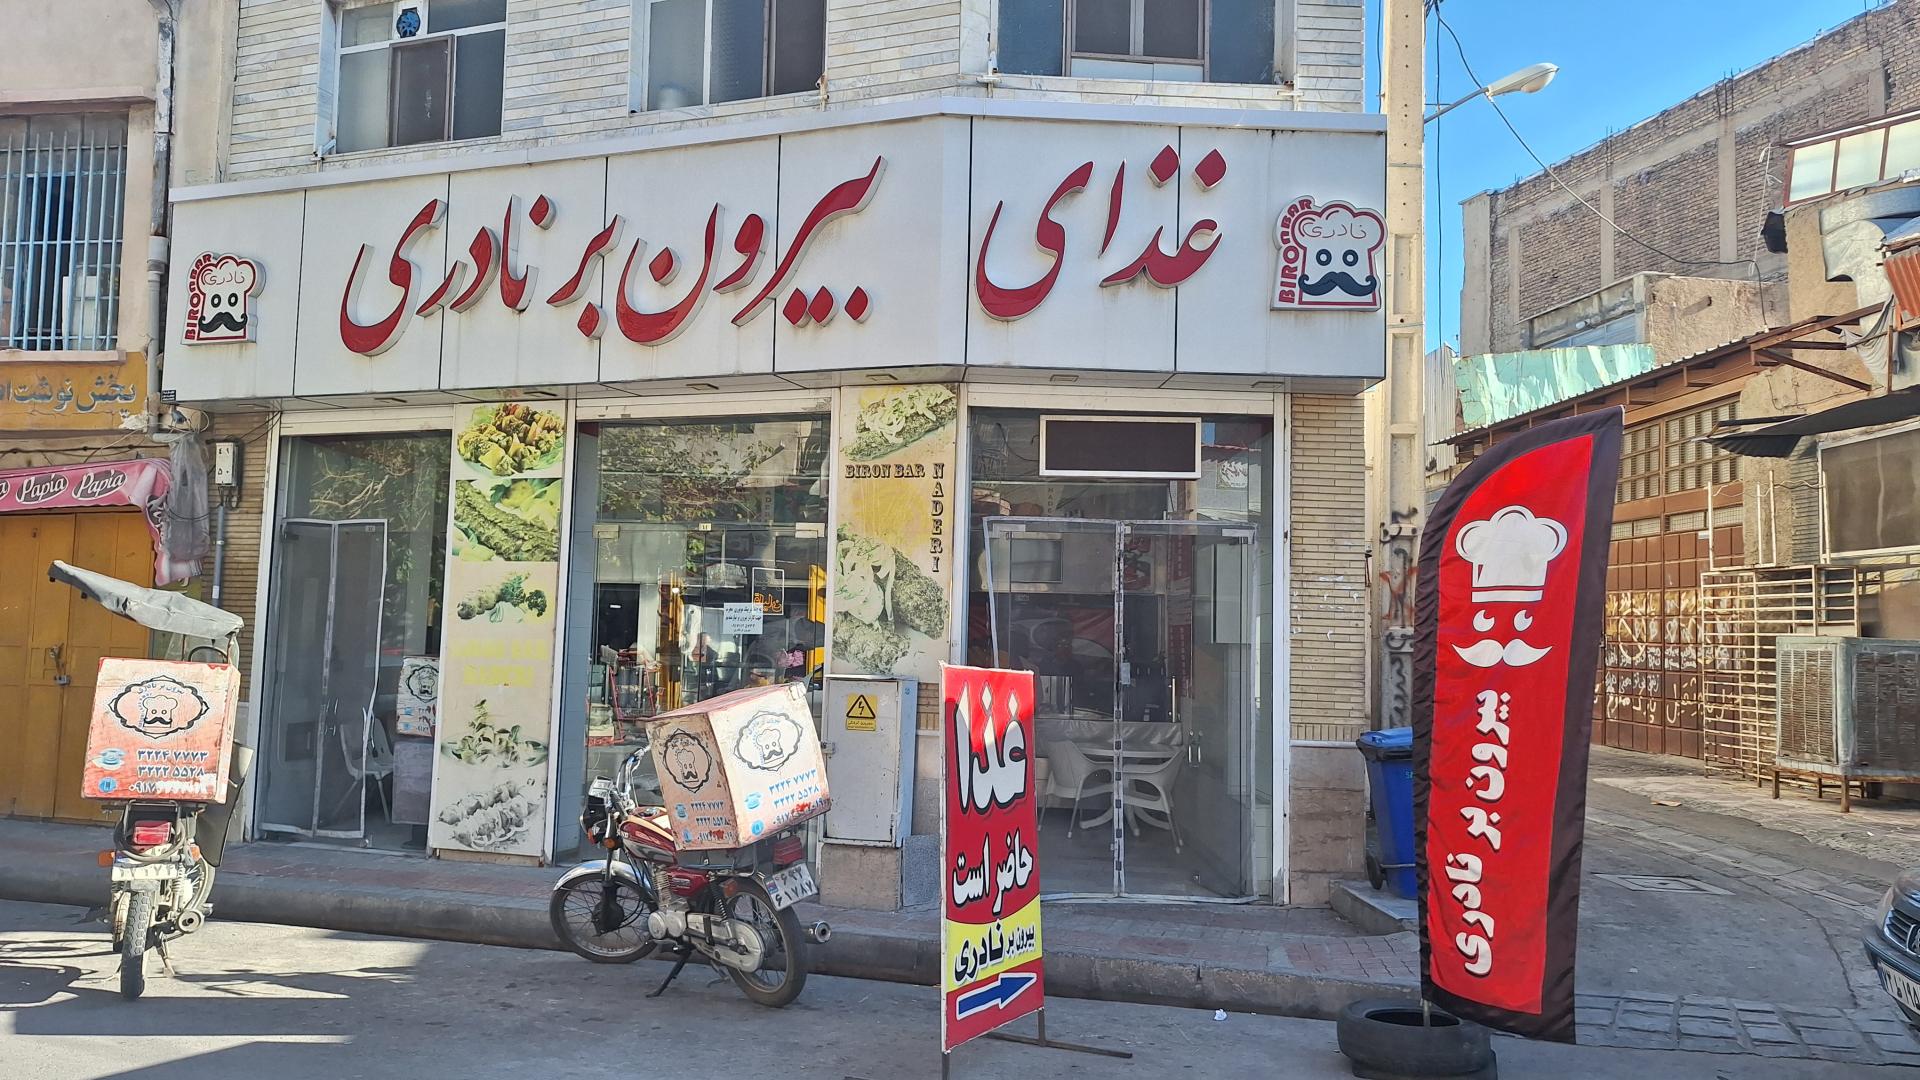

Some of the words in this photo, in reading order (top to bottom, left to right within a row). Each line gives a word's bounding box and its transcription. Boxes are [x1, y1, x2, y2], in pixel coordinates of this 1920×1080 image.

[615, 156, 888, 347] بیرون
[976, 144, 1229, 321] غذای
[1299, 221, 1367, 240] نادری
[203, 270, 246, 286] نادری
[339, 194, 556, 357] نادری
[546, 214, 626, 340] بر
[845, 464, 892, 479] BIRON
[894, 463, 926, 479] BAR
[930, 462, 945, 573] NADERI
[954, 680, 1027, 815] غذا
[1464, 688, 1511, 801] بیرون
[952, 834, 990, 907] است
[992, 828, 1034, 917] حاضر
[1459, 805, 1502, 851] بر
[953, 921, 1005, 983] نادری
[1005, 931, 1015, 955] بر
[1016, 924, 1036, 953] بیرون
[1444, 851, 1495, 977] نادری
